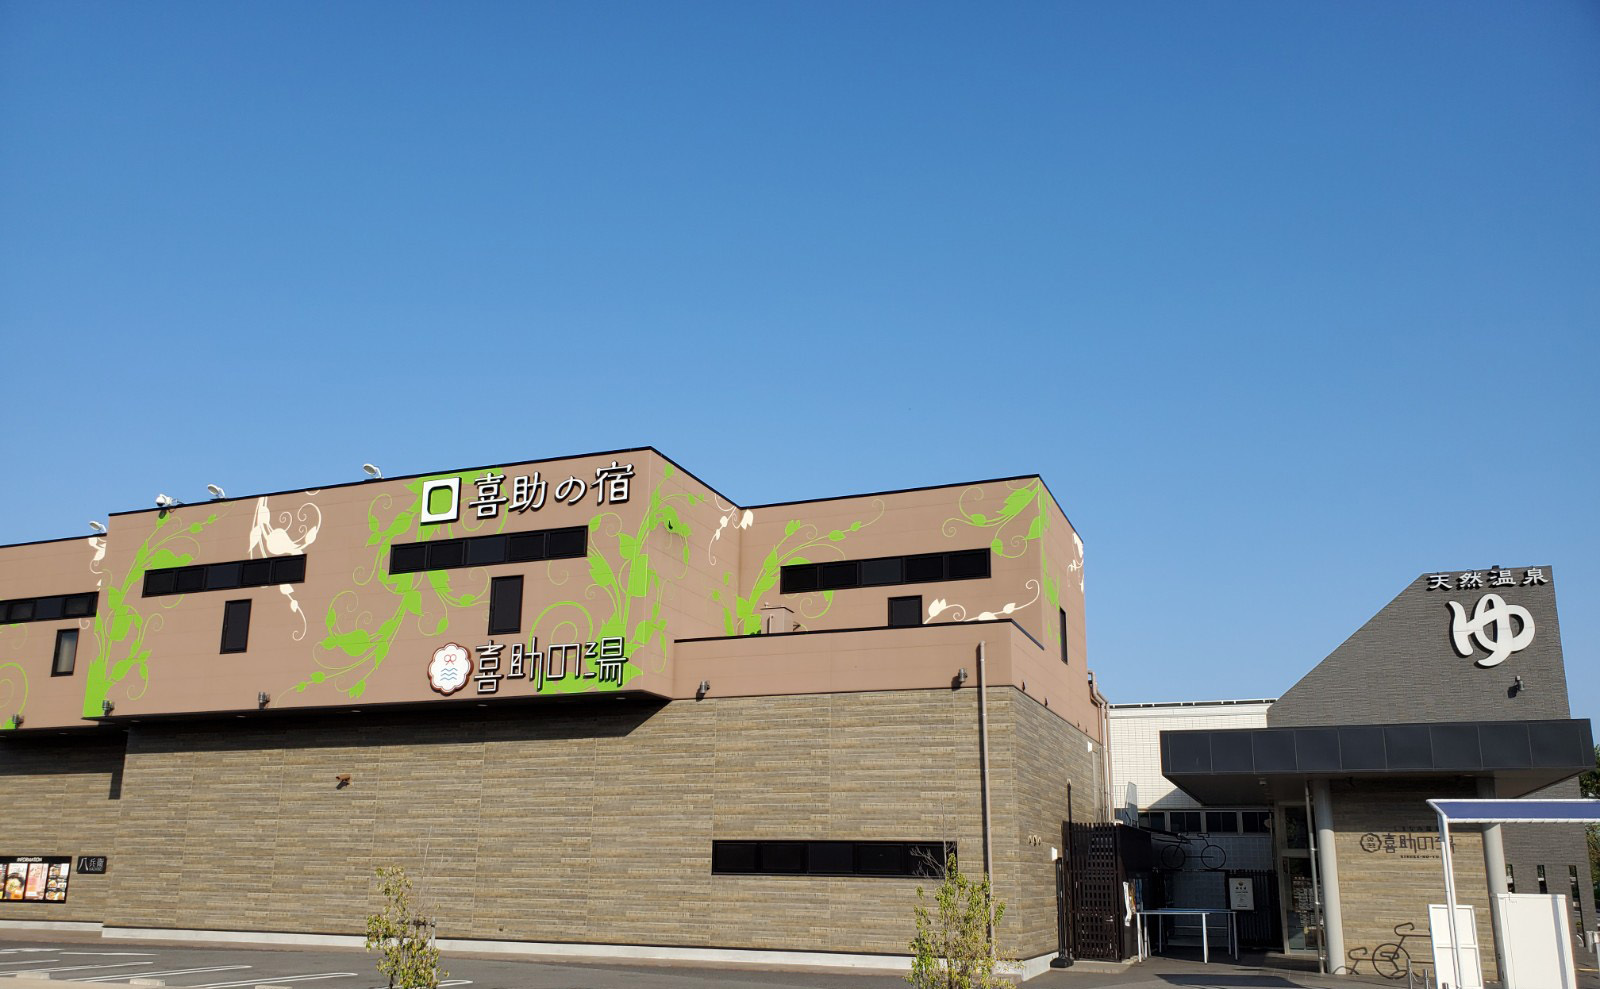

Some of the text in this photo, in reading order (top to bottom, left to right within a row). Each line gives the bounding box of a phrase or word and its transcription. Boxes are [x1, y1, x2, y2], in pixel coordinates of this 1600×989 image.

[469, 461, 633, 517] 喜助の宿
[1429, 567, 1548, 589] 天然温泉
[1448, 593, 1535, 667] ゆ
[474, 637, 628, 693] 喜助の湯
